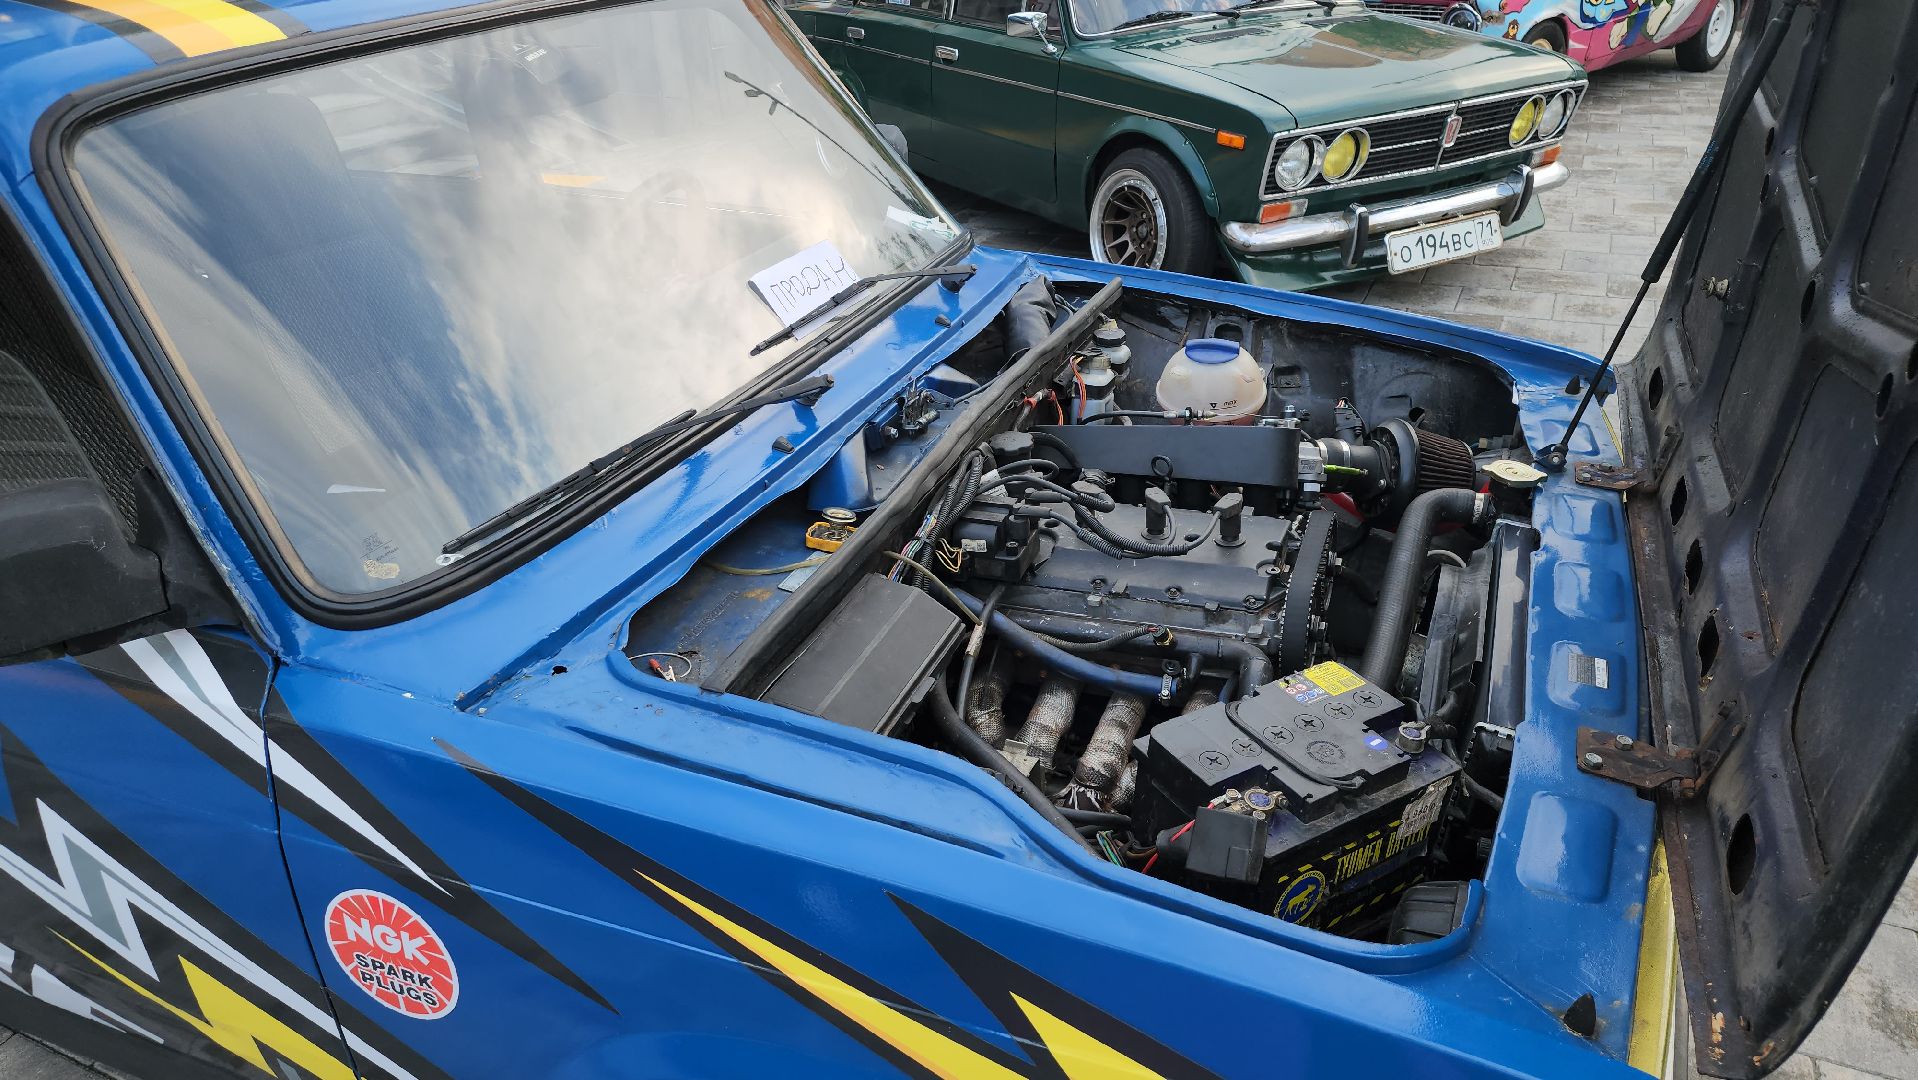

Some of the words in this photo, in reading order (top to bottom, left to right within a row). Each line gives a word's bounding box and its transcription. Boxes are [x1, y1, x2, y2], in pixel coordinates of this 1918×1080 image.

[1477, 219, 1494, 239] 71
[343, 913, 431, 966] NGK
[354, 953, 433, 990] SPARK
[360, 970, 438, 1006] PLUGS
